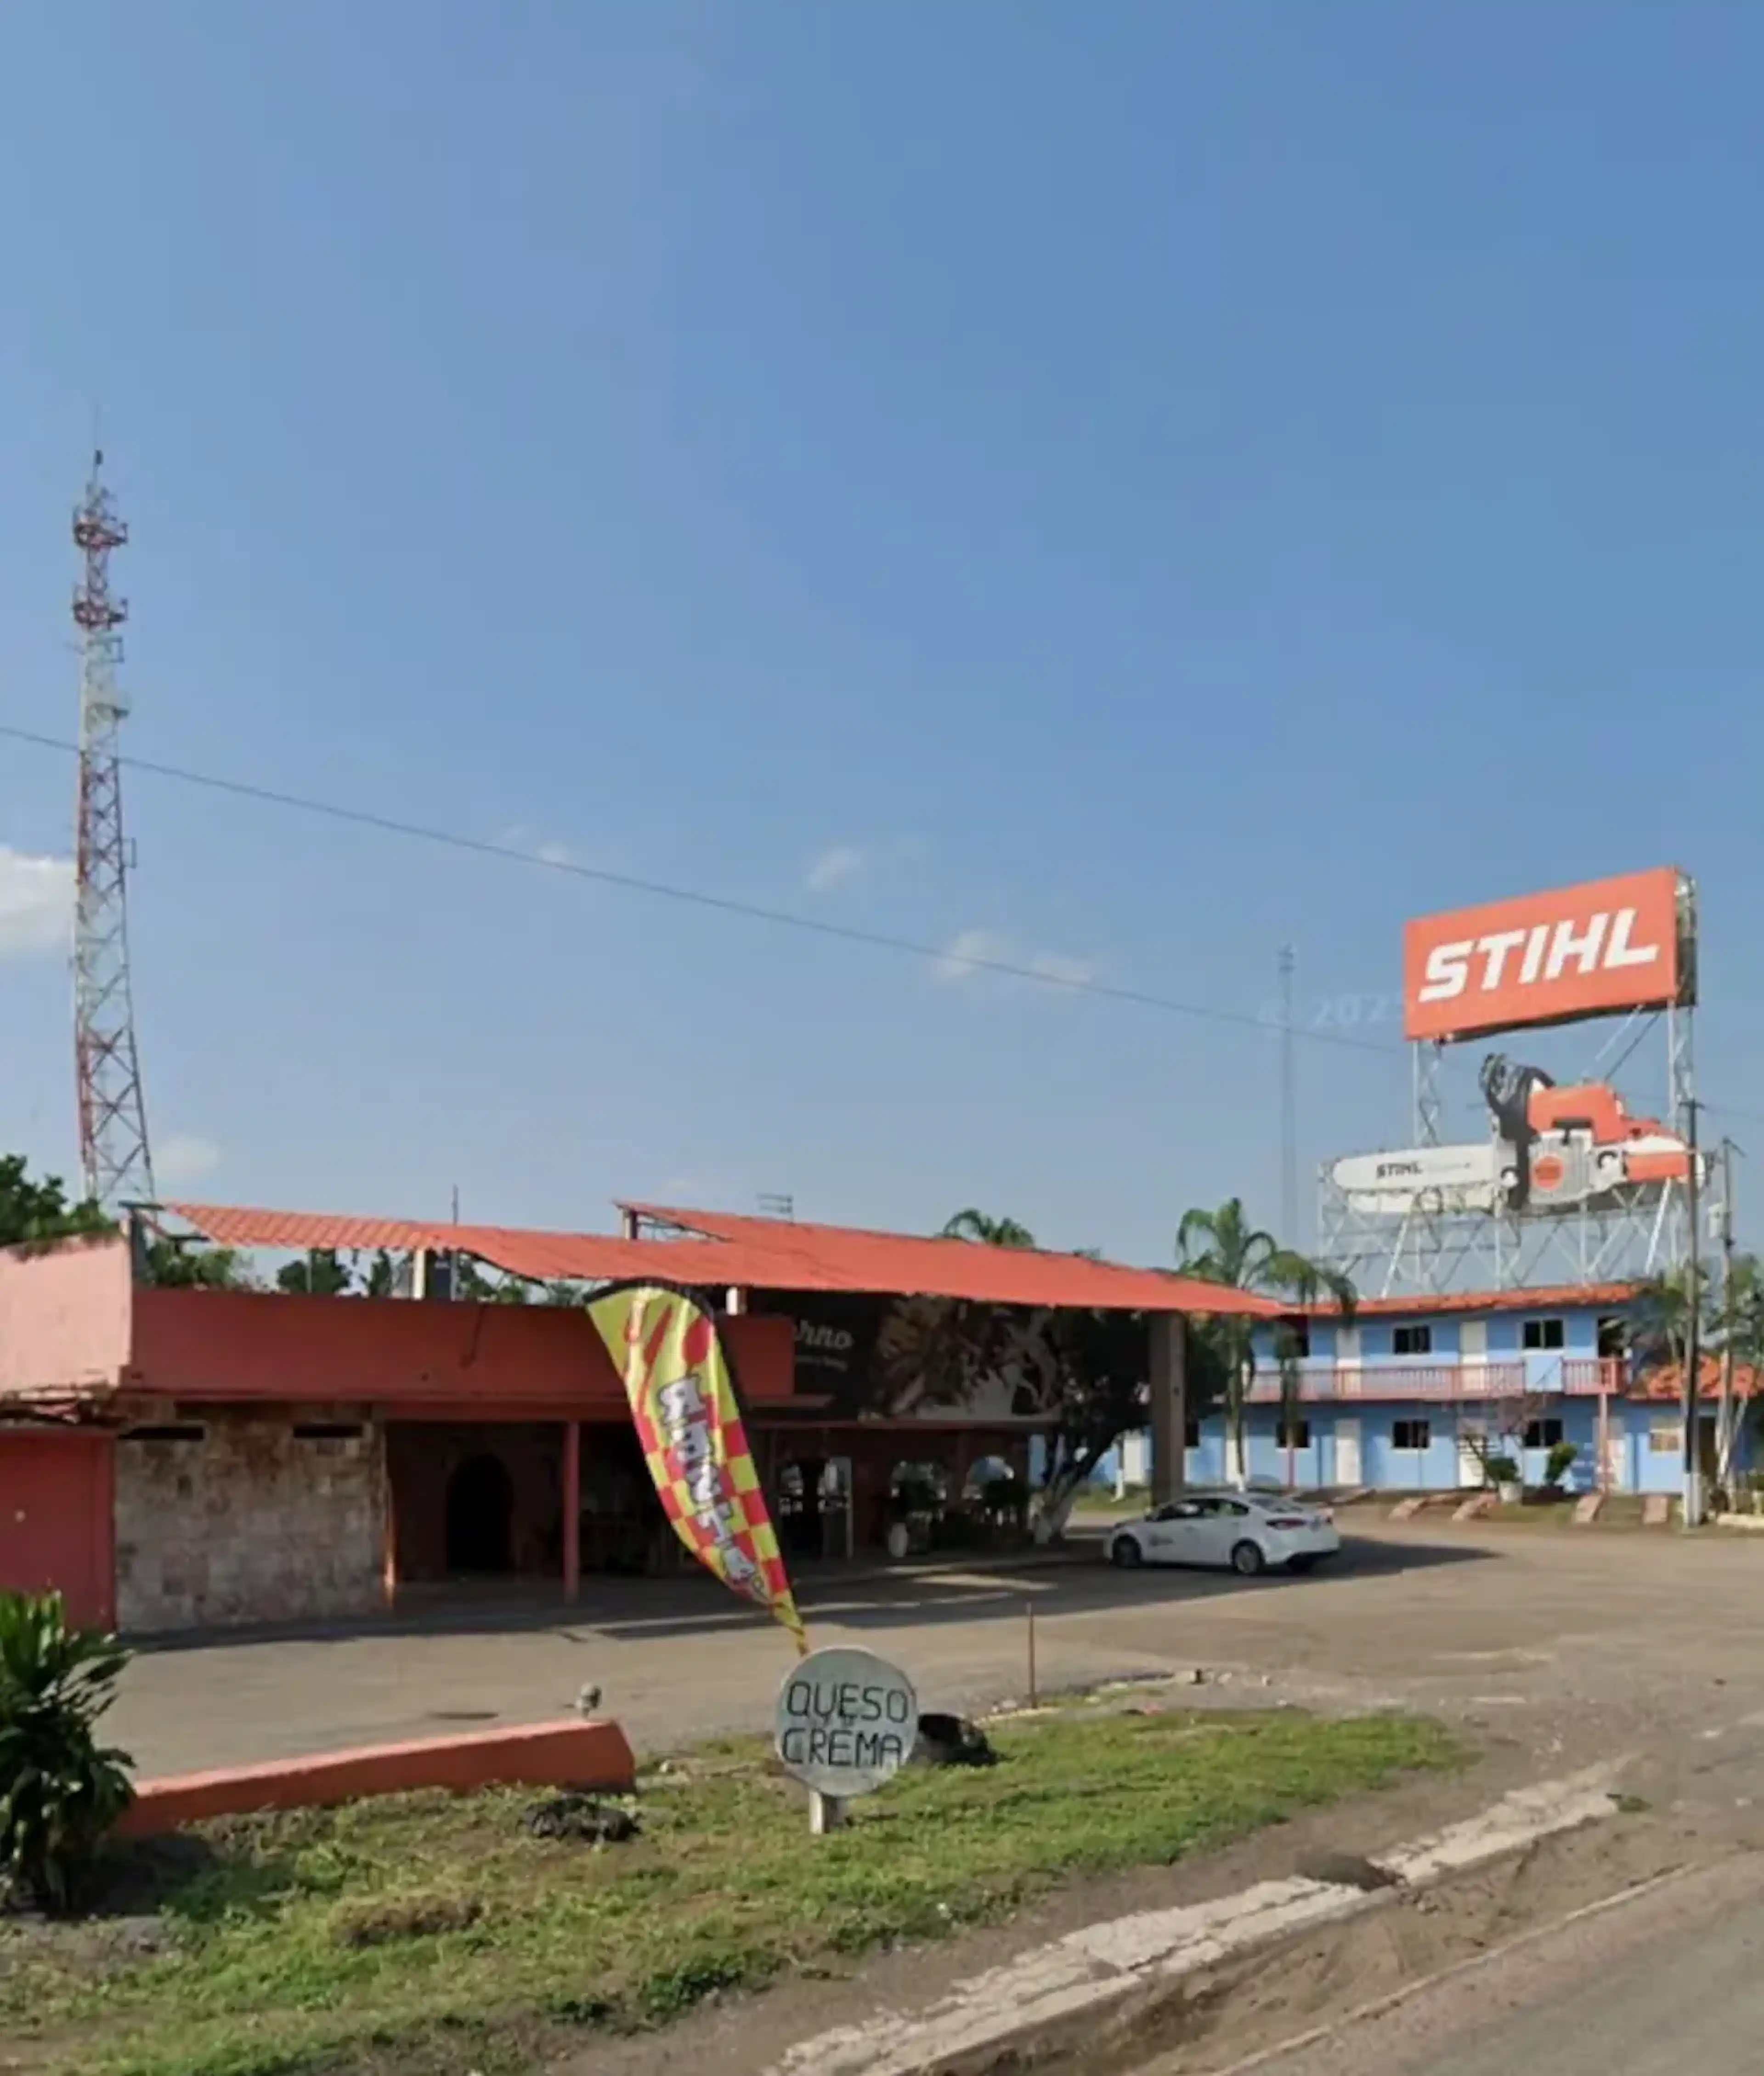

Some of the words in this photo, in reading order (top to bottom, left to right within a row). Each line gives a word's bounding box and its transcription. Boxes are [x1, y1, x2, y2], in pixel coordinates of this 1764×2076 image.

[1417, 907, 1661, 1004] STIHL
[786, 1680, 909, 1724] QUESO
[782, 1727, 903, 1769] CREMA
